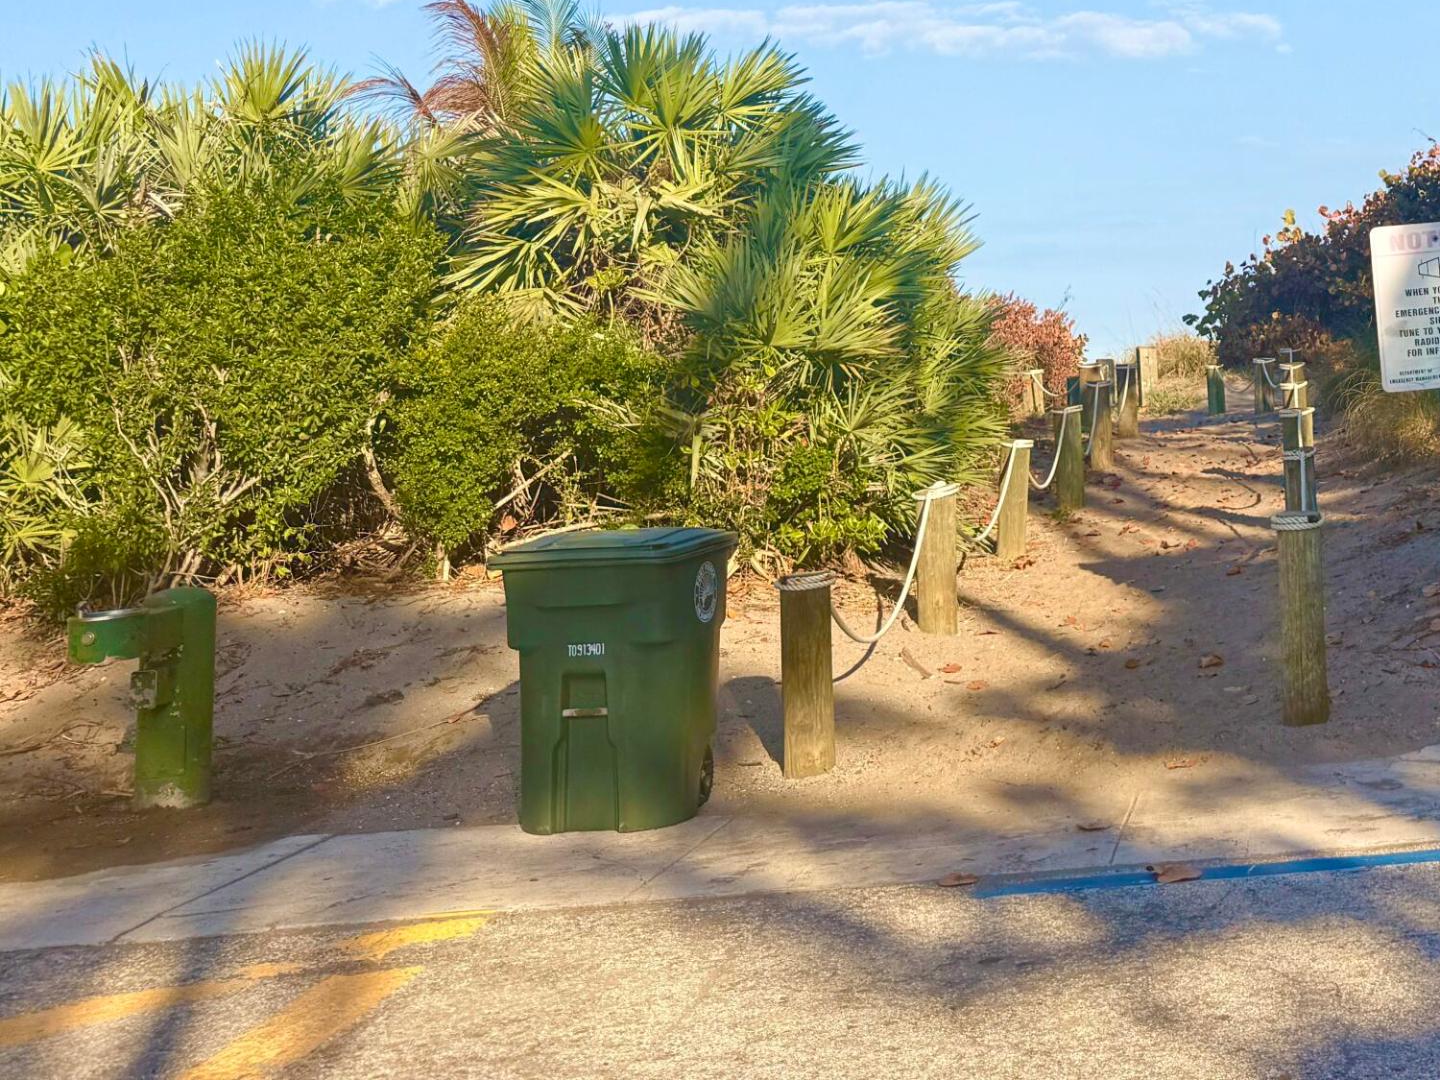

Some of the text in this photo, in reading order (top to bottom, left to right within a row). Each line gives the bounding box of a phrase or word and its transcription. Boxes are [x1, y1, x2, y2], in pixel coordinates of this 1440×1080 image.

[1404, 287, 1429, 297] WHEN
[1399, 328, 1420, 338] TUNE
[1424, 327, 1433, 336] TO
[1414, 337, 1440, 347] RADIO
[1407, 348, 1423, 357] FOR
